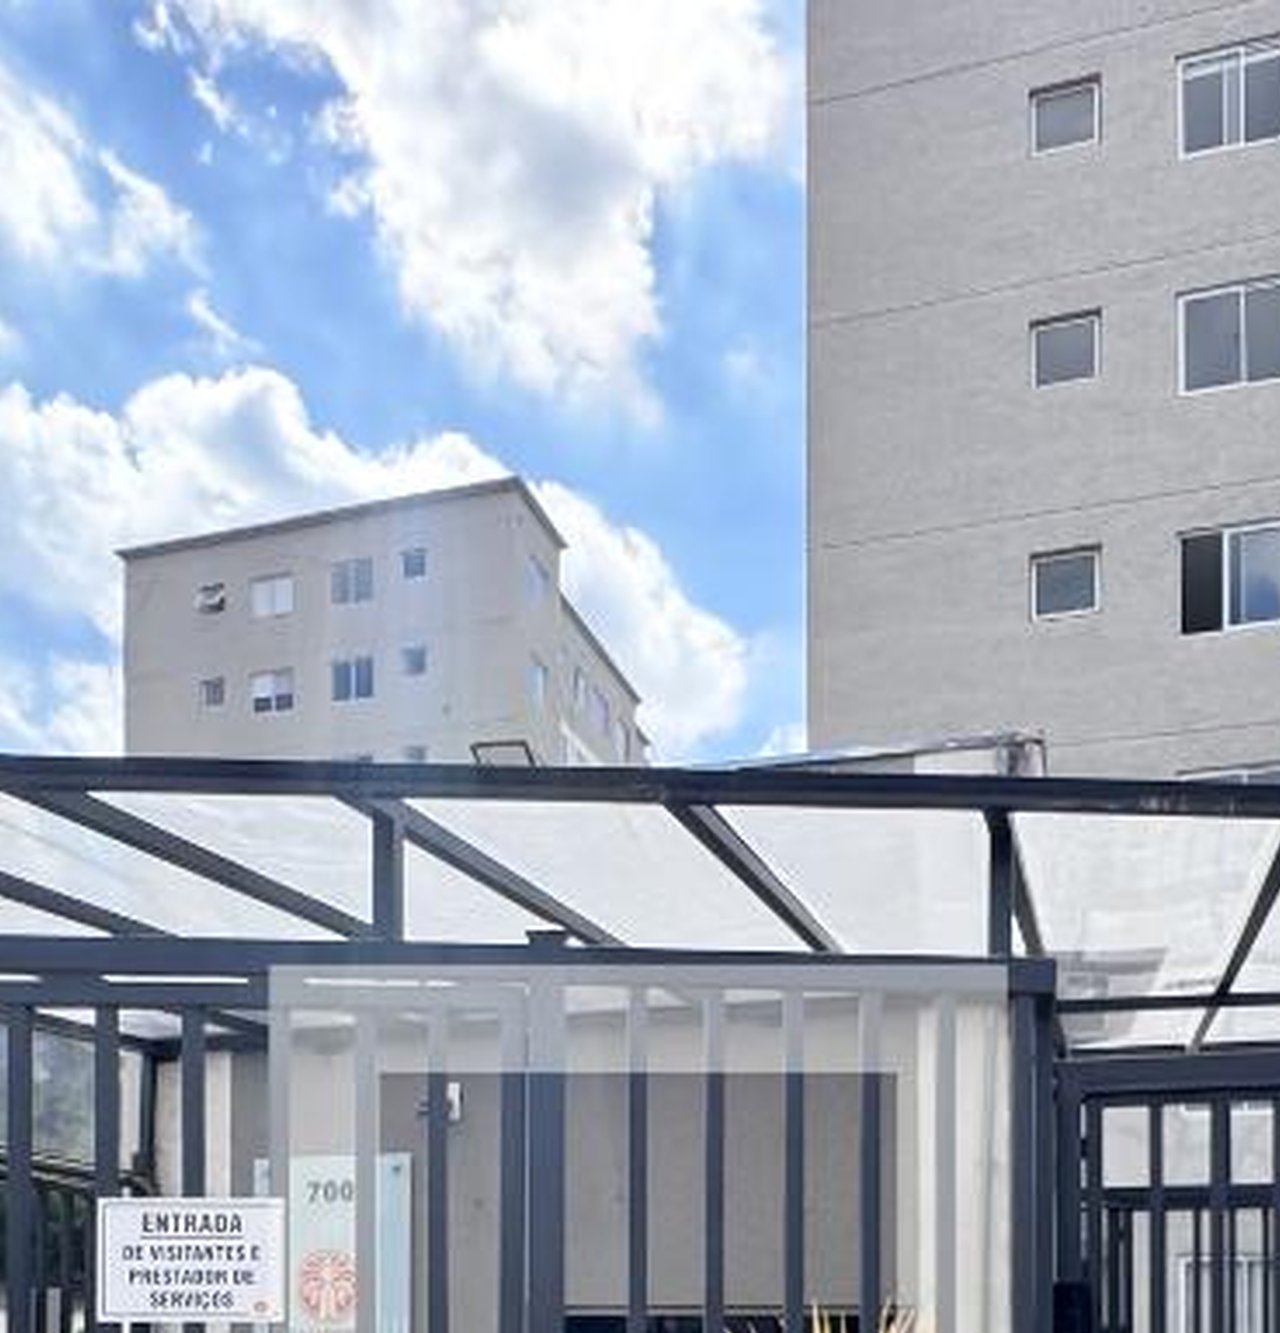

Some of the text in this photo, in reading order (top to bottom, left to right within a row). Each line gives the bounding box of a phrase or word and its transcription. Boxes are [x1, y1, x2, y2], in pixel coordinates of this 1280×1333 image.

[306, 1180, 353, 1203] 700
[142, 1213, 243, 1234] ENTRADA
[122, 1245, 261, 1261] DE VISITANTES E
[128, 1269, 256, 1286] PRESTADOR DE
[149, 1290, 235, 1309] SERVIÇOS
